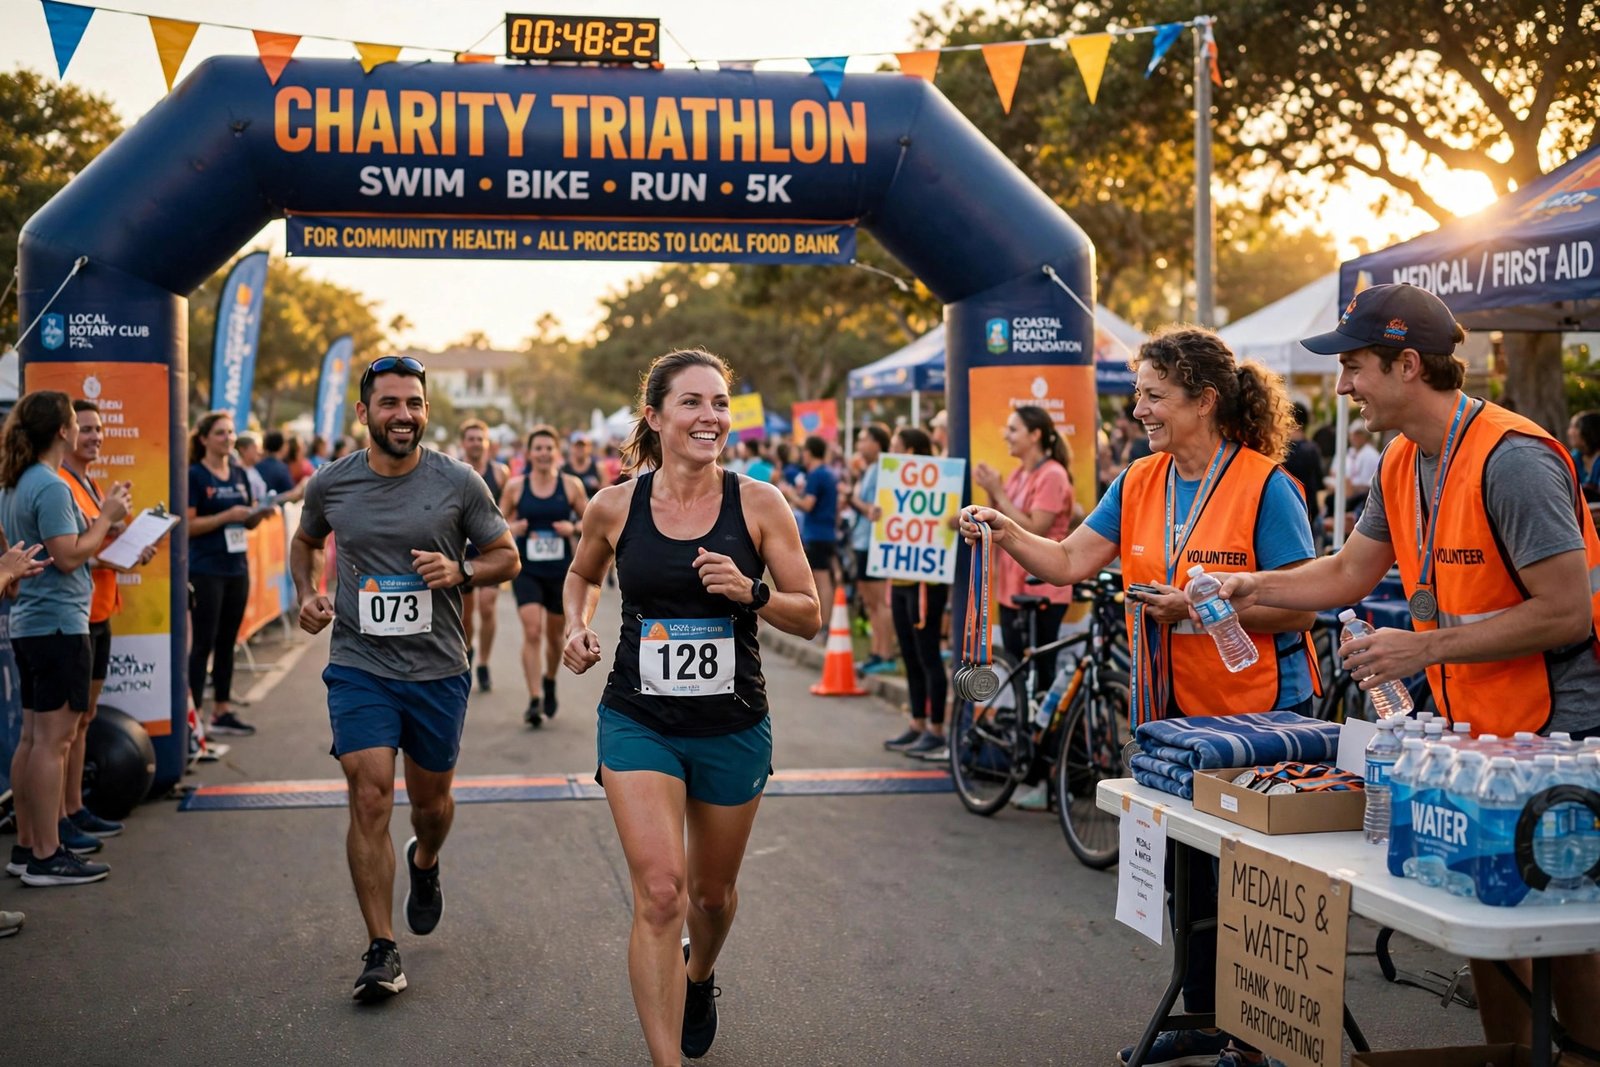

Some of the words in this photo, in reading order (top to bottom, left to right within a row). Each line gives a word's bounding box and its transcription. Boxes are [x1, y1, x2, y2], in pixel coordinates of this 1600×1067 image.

[510, 18, 656, 57] 00:48:22
[274, 85, 537, 158] CHARITY
[551, 93, 867, 165] TRIATHLON
[359, 165, 465, 198] SWIM
[506, 169, 590, 200] BIKE
[630, 171, 707, 202] RUN
[745, 173, 793, 203] 5K
[303, 226, 338, 247] FOR
[342, 227, 448, 249] COMMUNITY
[452, 229, 517, 250] HEALTH
[538, 230, 569, 251] ALL
[573, 230, 661, 252] PROCEEDS
[664, 232, 686, 252] TO
[690, 232, 743, 253] LOCAL
[746, 233, 791, 254] FOOD
[794, 234, 840, 255] BANK
[1392, 258, 1474, 296] MEDICAL
[1492, 246, 1550, 288] FIRST
[1554, 240, 1594, 281] AID
[68, 313, 109, 325] LOCAL
[68, 325, 117, 337] ROTARY
[119, 325, 150, 338] CLUB
[1012, 317, 1063, 329] COASTAL
[1012, 328, 1057, 341] HEALTH
[1012, 340, 1082, 353] FOUNDATION
[901, 460, 939, 488] GO
[894, 488, 947, 516] YOU
[885, 516, 940, 544] GOT
[879, 543, 947, 576] THIS!
[1187, 550, 1248, 566] VOLUNTEER
[1434, 548, 1486, 565] VOLUNTEER
[370, 594, 419, 623] 073
[109, 653, 138, 665] OCAL
[657, 642, 719, 681] 128
[1411, 799, 1469, 847] WATER
[1231, 860, 1306, 924] MEDALS
[1314, 894, 1329, 935] &
[1243, 914, 1309, 981] WATER
[1233, 962, 1270, 1003] THANK
[1274, 981, 1296, 1015] YOU
[1299, 994, 1321, 1028] FOR
[1240, 1001, 1325, 1067] PARTICIPATING!
